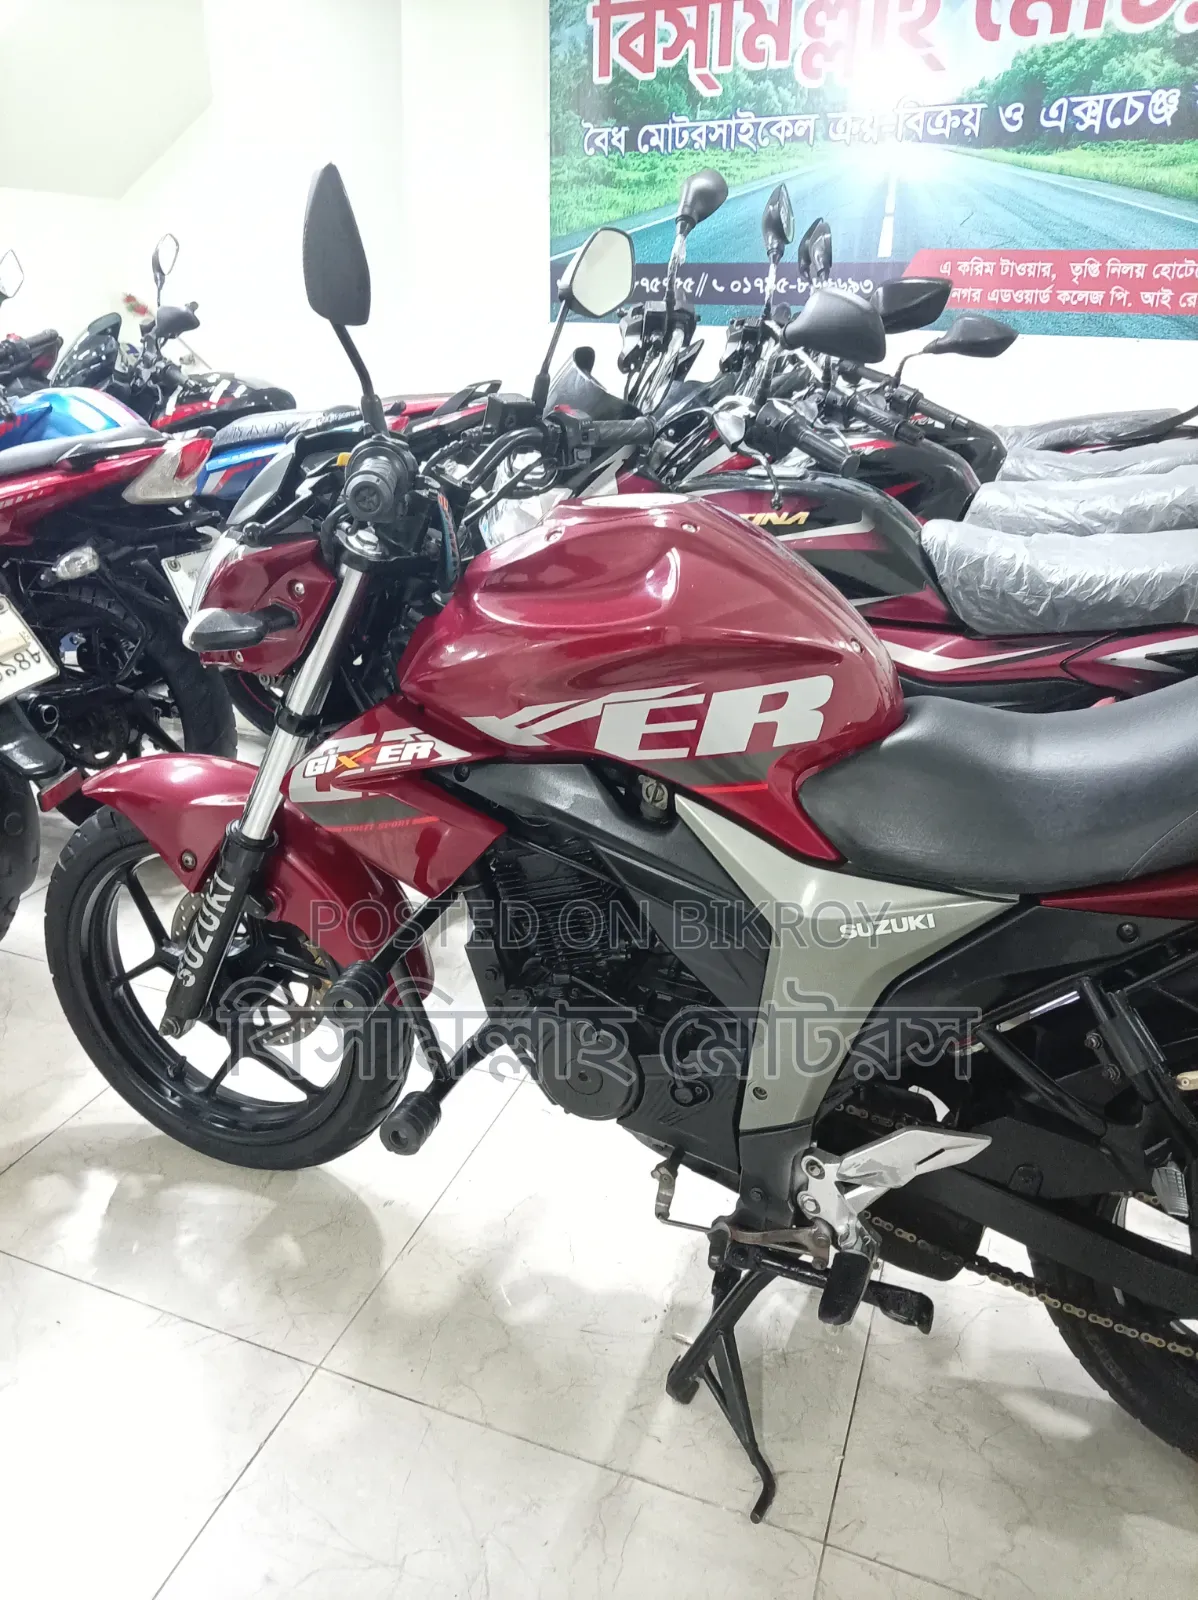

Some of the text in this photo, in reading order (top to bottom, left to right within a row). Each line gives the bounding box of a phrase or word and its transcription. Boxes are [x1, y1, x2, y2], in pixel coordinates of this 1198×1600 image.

[583, 120, 629, 158] বৈধ
[637, 109, 820, 155] মোটরসাইকেল
[999, 102, 1024, 133] ও
[940, 261, 952, 276] এ
[957, 256, 996, 276] করিম
[1106, 257, 1148, 279] নিলয়
[987, 284, 1055, 304] এডওয়ার্ড
[1056, 290, 1106, 306] কলেজ
[1140, 287, 1174, 309] আই
[177, 871, 235, 987] SUZUKI
[839, 913, 937, 940] SUZUKI
